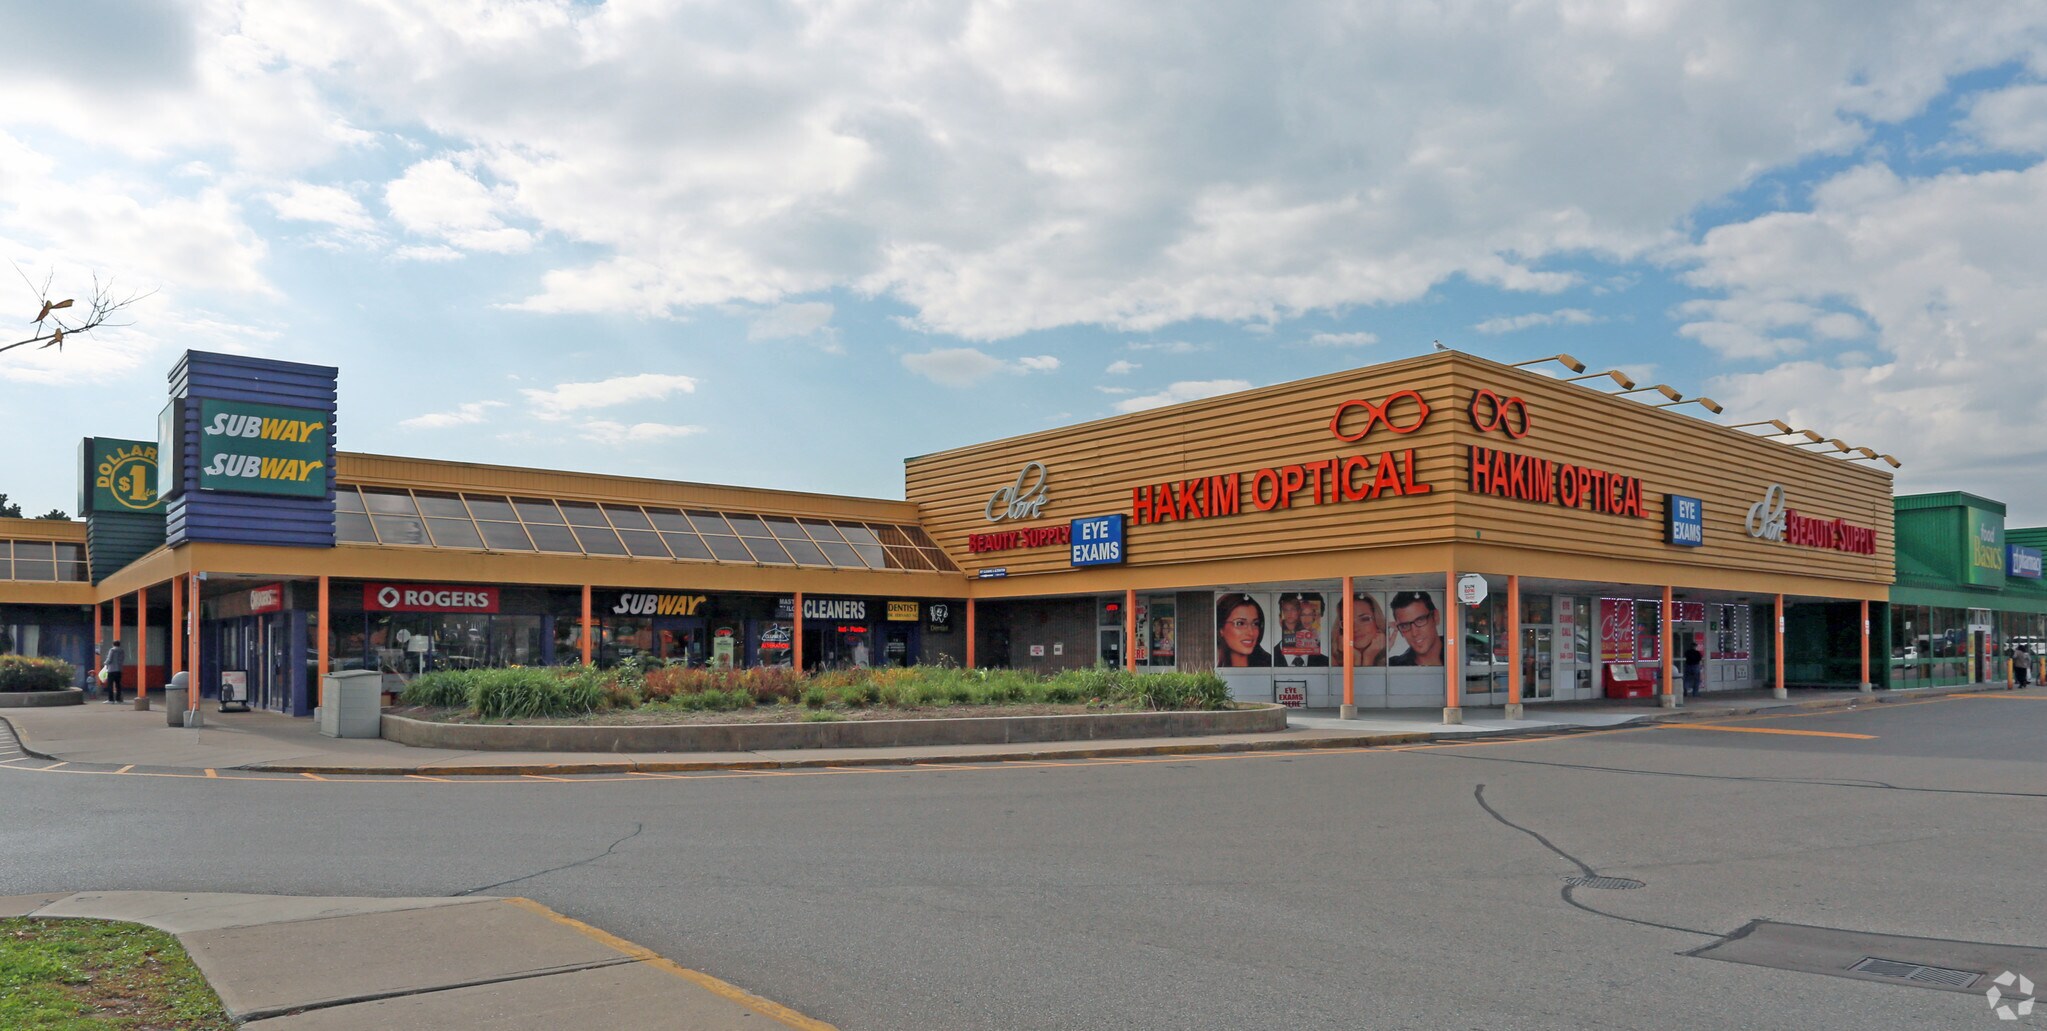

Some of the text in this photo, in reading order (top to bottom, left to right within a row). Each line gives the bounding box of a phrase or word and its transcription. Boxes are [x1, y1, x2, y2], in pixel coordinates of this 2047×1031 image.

[204, 412, 325, 443] SUBWAY
[96, 444, 158, 488] DOLLAR
[203, 452, 325, 482] SUBWAY
[1132, 448, 1432, 526] HAKIM OPTICAL
[1468, 444, 1650, 519] HAKIM OPTICAL
[1679, 500, 1696, 520] EYE
[968, 525, 1072, 553] BEAUTY SUPPLY
[1082, 520, 1110, 541] EYE
[1673, 522, 1702, 543] EXAMS
[1788, 509, 1877, 555] BEAUTY SUPPLY
[1981, 522, 1995, 543] food
[1073, 541, 1120, 563] EXAMS
[404, 589, 490, 609] ROGERS
[612, 593, 707, 617] SUBWAY
[803, 599, 866, 619] CLEANERS
[888, 603, 917, 612] DENTIST
[1279, 693, 1304, 701] EXAMS
